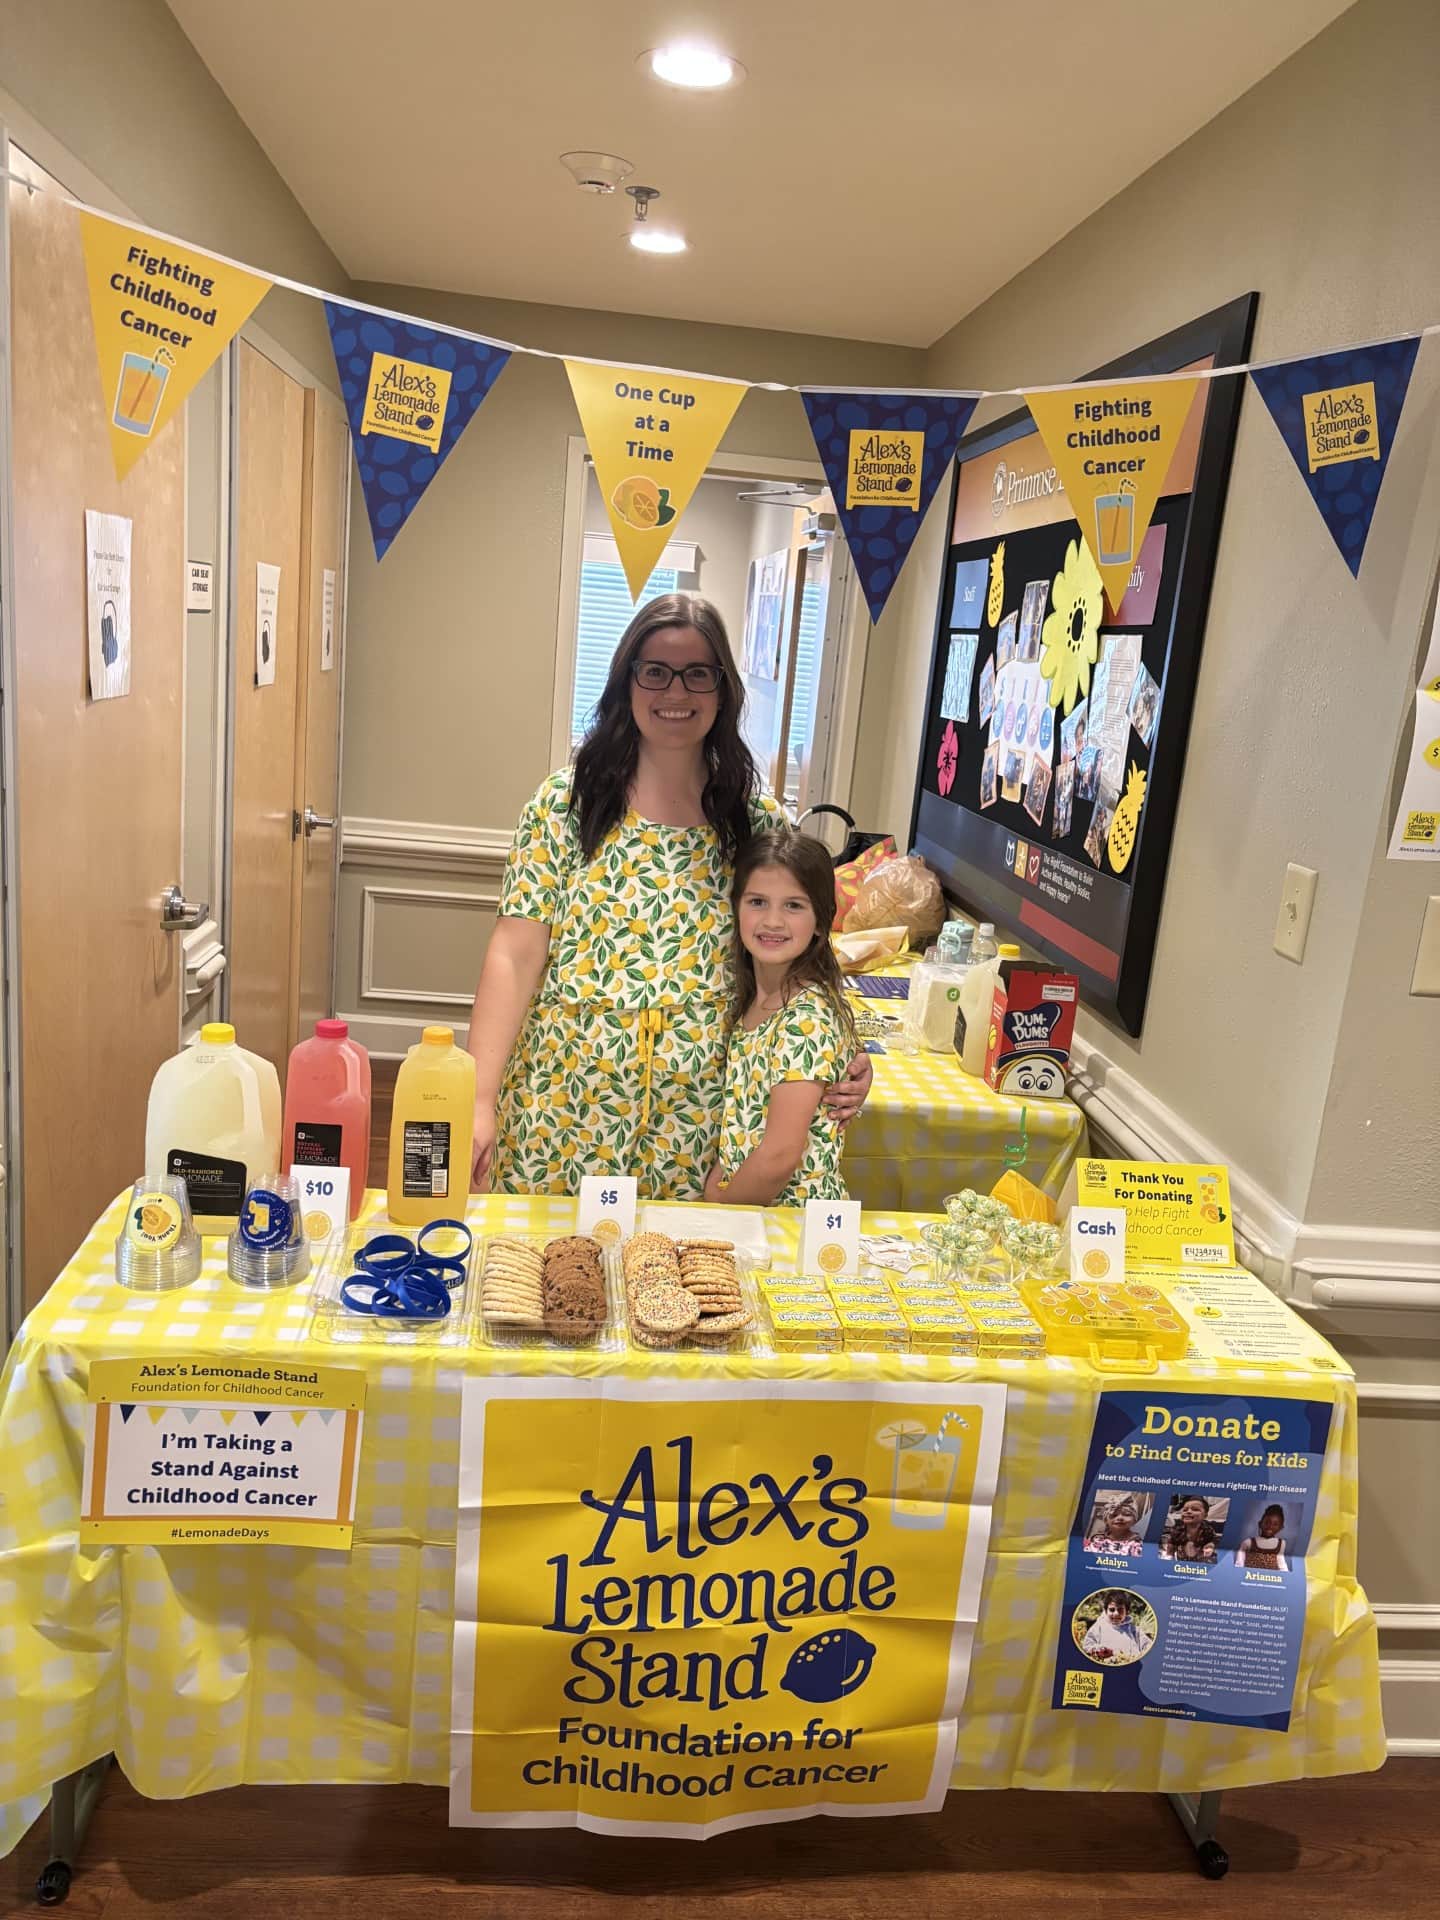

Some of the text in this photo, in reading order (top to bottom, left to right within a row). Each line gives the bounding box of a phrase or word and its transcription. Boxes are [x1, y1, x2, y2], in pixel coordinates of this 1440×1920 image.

[127, 246, 215, 296] Fighting
[110, 273, 217, 326] Childhood
[120, 310, 192, 348] Cancer
[382, 364, 436, 398] Alex's
[372, 384, 440, 414] Lemonade
[615, 382, 696, 410] One Cup
[374, 402, 414, 425] Stand
[1074, 398, 1152, 421] Fighting
[1314, 394, 1364, 424] Alex's
[634, 415, 670, 432] at a
[1312, 414, 1372, 438] Lemonade
[1066, 425, 1160, 448] Childhood
[1316, 432, 1352, 454] Stand
[626, 440, 674, 462] Time
[860, 436, 911, 462] Alex's
[853, 458, 916, 478] Lemonade
[1084, 458, 1146, 476] Cancer
[856, 475, 892, 492] Stand
[1006, 466, 1056, 506] Primrose
[192, 568, 200, 578] CAR
[1012, 1026, 1048, 1041] DUMS
[296, 1154, 336, 1162] LEMONADE
[306, 1180, 334, 1196] $10
[1121, 1172, 1184, 1185] Thank You
[600, 1190, 618, 1204] $5
[1114, 1188, 1193, 1204] For Donating
[826, 1214, 842, 1229] $1
[1135, 1207, 1160, 1220] Help
[1162, 1207, 1190, 1222] Fight
[1078, 1220, 1116, 1236] Cash
[1125, 1223, 1204, 1236] ldhood Cancer
[140, 1364, 318, 1384] Alex's Lemonade Stand
[131, 1382, 324, 1399] Foundation for Childhood Cancer
[1142, 1406, 1281, 1442] Donate
[162, 1433, 292, 1454] I'm Taking a
[1105, 1444, 1308, 1469] to Find Cures for Kids
[151, 1460, 299, 1480] Stand Against
[1098, 1474, 1308, 1494] Meet the Childhood Cancer Heroes Fighting Their Disease
[127, 1488, 318, 1506] Childhood Cancer
[579, 1436, 870, 1567] Alex's
[171, 1528, 270, 1539] #LemonadeDays
[1096, 1556, 1128, 1568] Adalyn
[1174, 1564, 1208, 1576] Gabriel
[1245, 1571, 1282, 1582] Arianna
[542, 1550, 896, 1634] Lemonade
[1238, 1602, 1271, 1611] Foundation
[563, 1633, 770, 1711] Stand
[557, 1716, 862, 1757] Foundation for
[522, 1756, 888, 1797] Childhood Cancer
